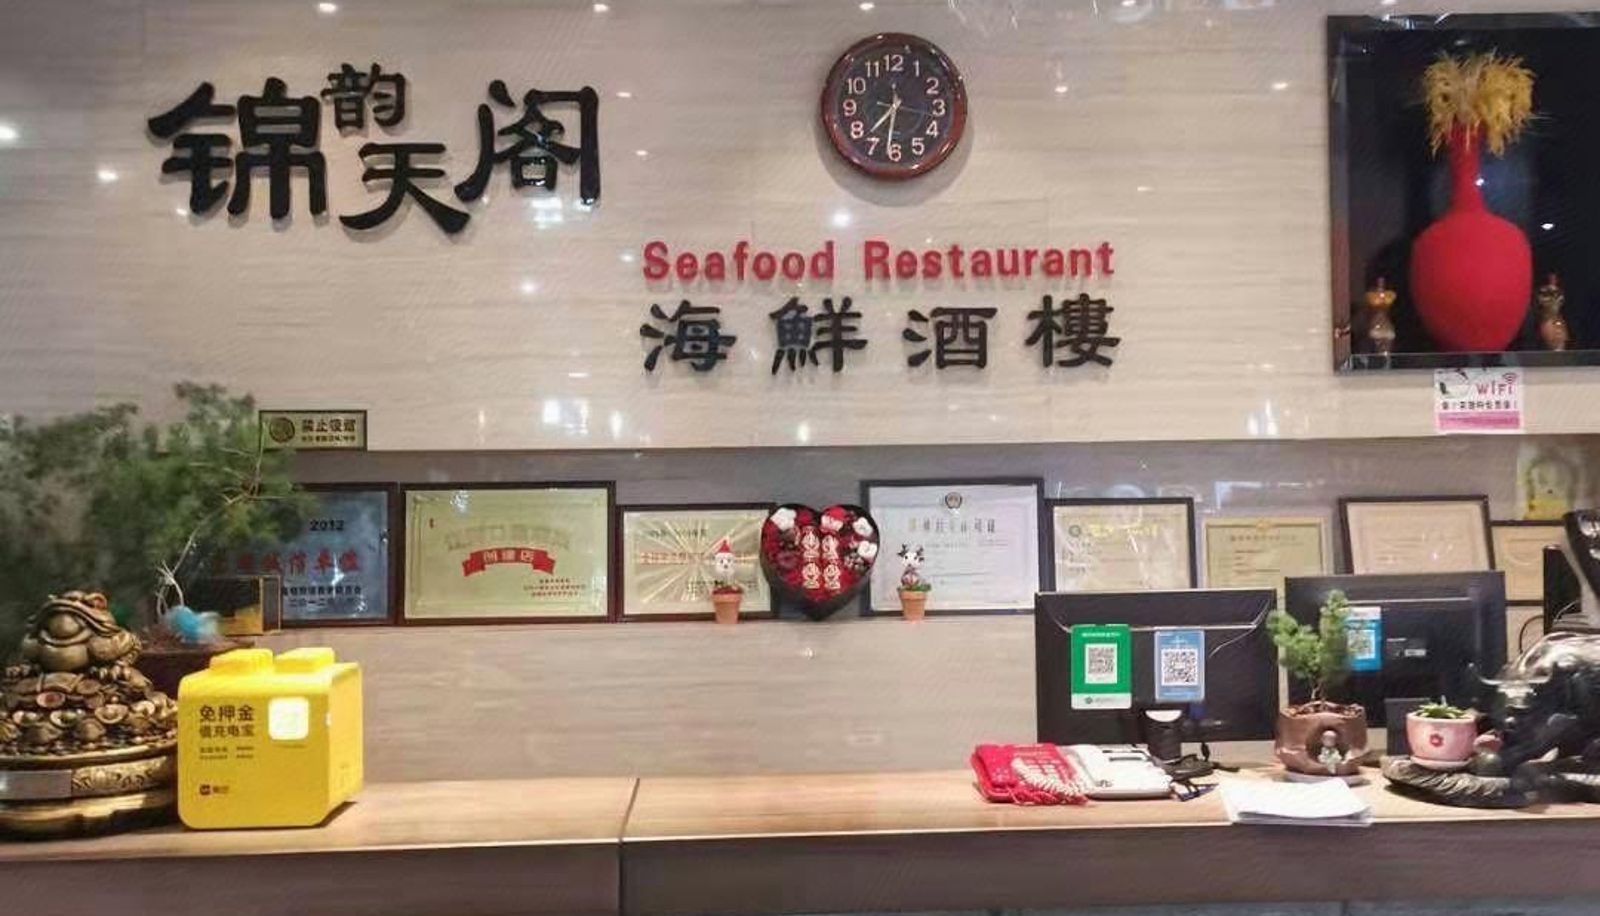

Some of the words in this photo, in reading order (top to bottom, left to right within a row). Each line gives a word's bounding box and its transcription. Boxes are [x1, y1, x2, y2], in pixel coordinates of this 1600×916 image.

[865, 61, 880, 77] 11
[884, 54, 904, 71] 12
[913, 60, 920, 77] 1
[847, 77, 866, 94] 10
[926, 78, 939, 94] 2
[842, 99, 857, 116] 9
[932, 98, 946, 116] 3
[851, 121, 864, 139] 8
[925, 120, 939, 137] 4
[866, 137, 880, 155] 7
[888, 143, 902, 162] 6
[912, 138, 925, 155] 5
[642, 240, 835, 281] Seafood
[863, 241, 1116, 281] Restaurant
[199, 704, 255, 723] 免押金
